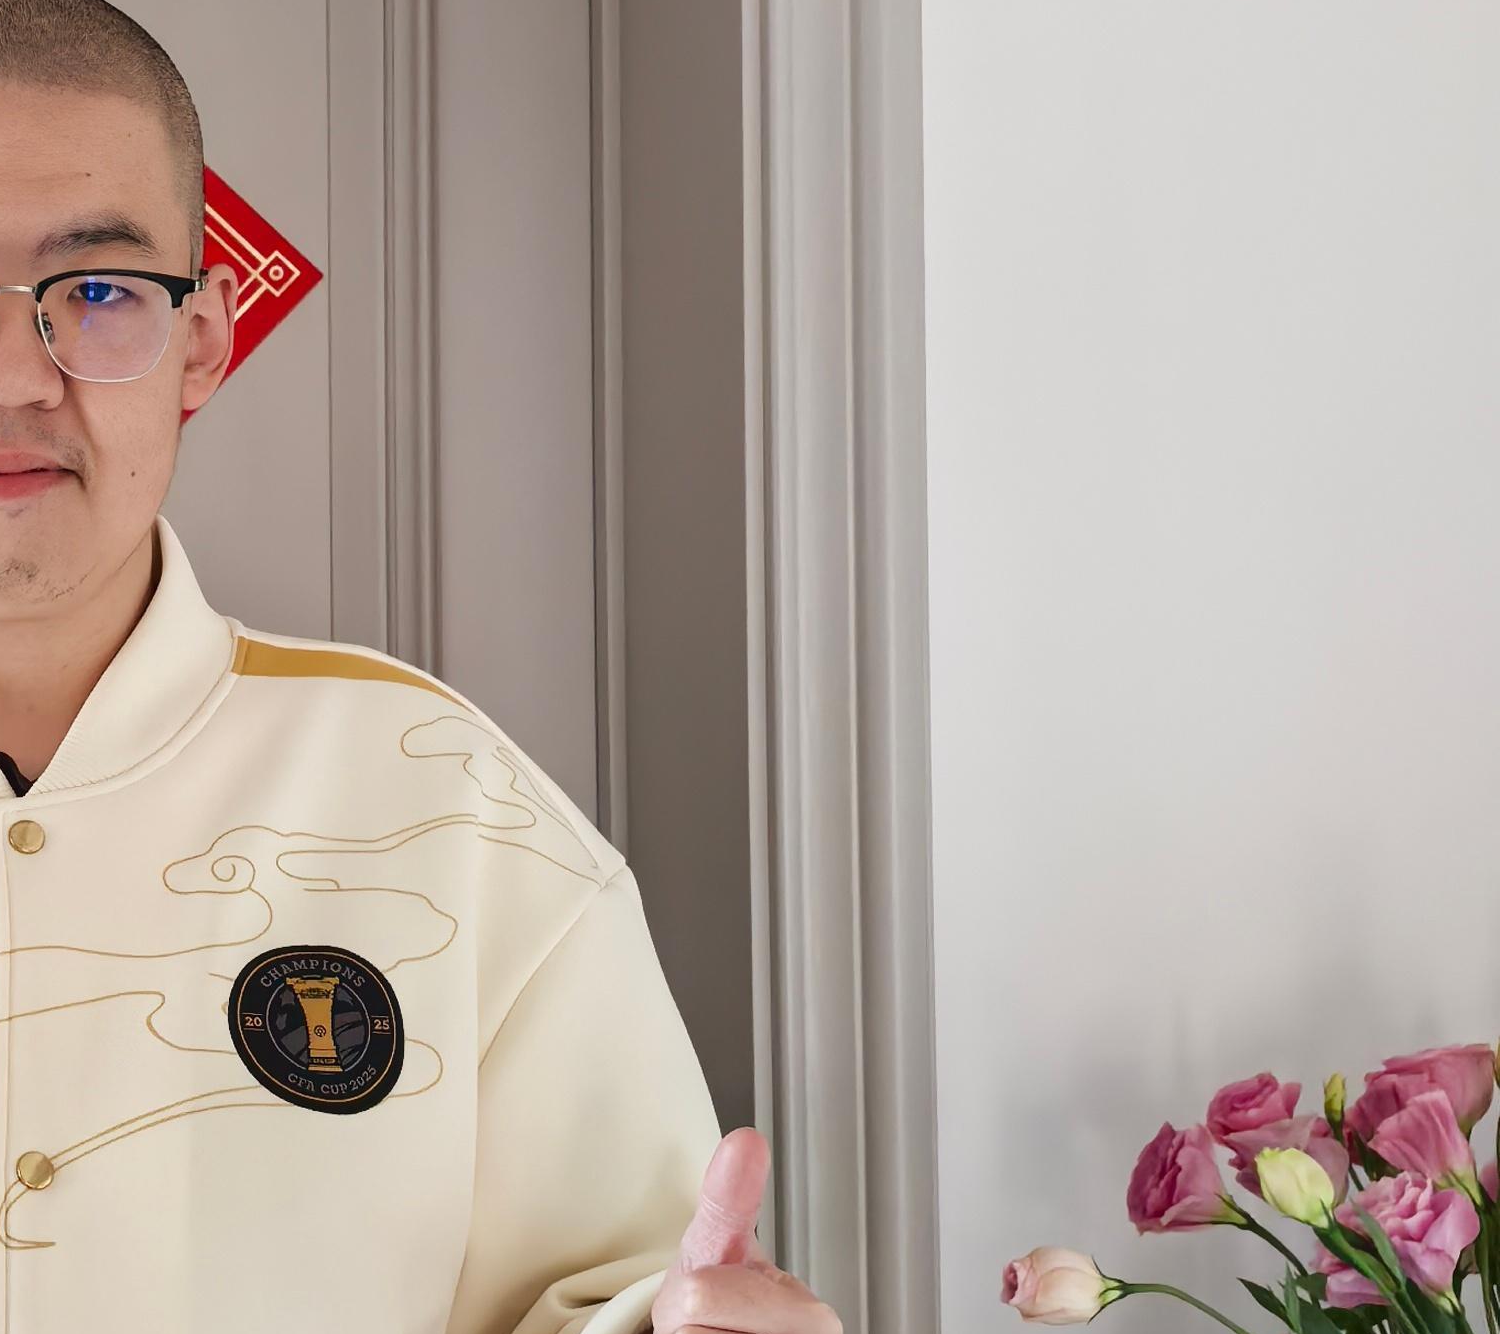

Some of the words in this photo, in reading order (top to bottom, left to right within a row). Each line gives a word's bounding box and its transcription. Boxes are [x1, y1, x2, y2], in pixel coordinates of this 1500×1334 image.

[260, 959, 366, 988] CHAMPIONS
[245, 1016, 262, 1027] 20
[373, 1018, 390, 1030] 25
[287, 1072, 315, 1092] CFA
[320, 1082, 347, 1095] CUP
[348, 1064, 377, 1092] 2025
